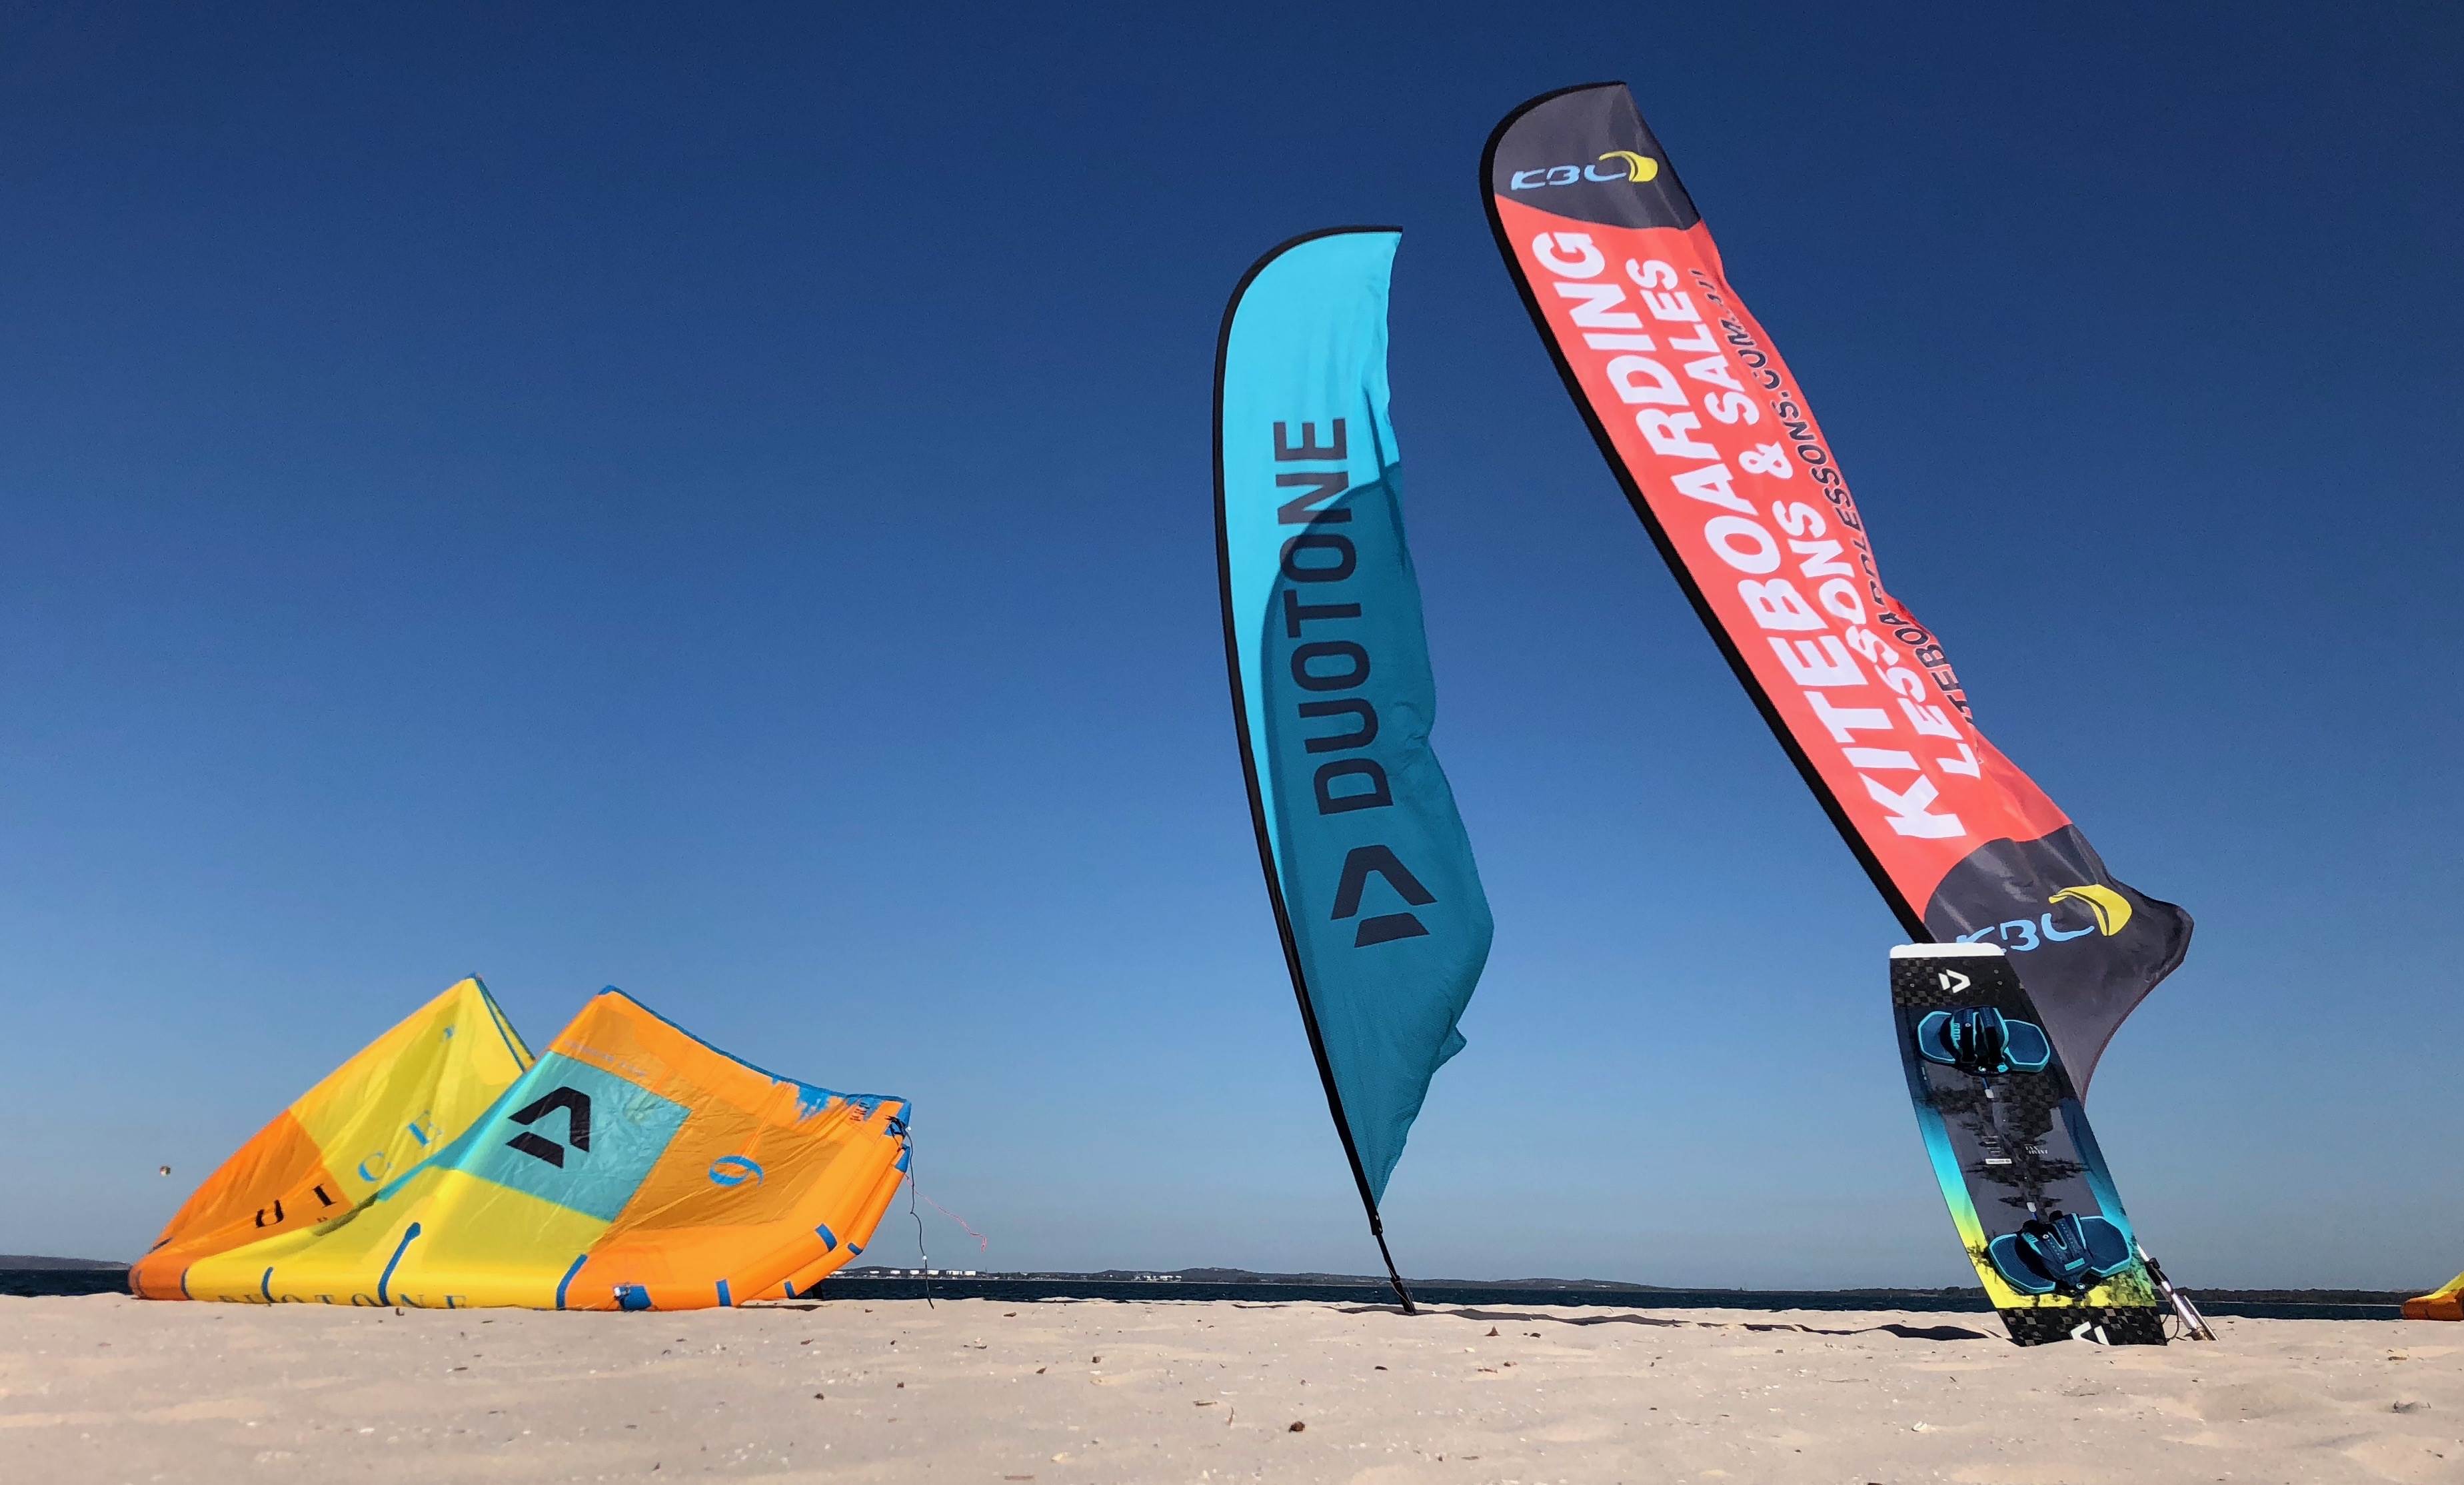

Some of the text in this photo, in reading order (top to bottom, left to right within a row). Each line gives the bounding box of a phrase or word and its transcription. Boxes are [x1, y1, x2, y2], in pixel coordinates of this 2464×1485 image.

[1272, 416, 1394, 816] DUOTONE
[1532, 231, 1967, 839] KITEBOARDING
[1625, 257, 1981, 779] LESSONS & SALES
